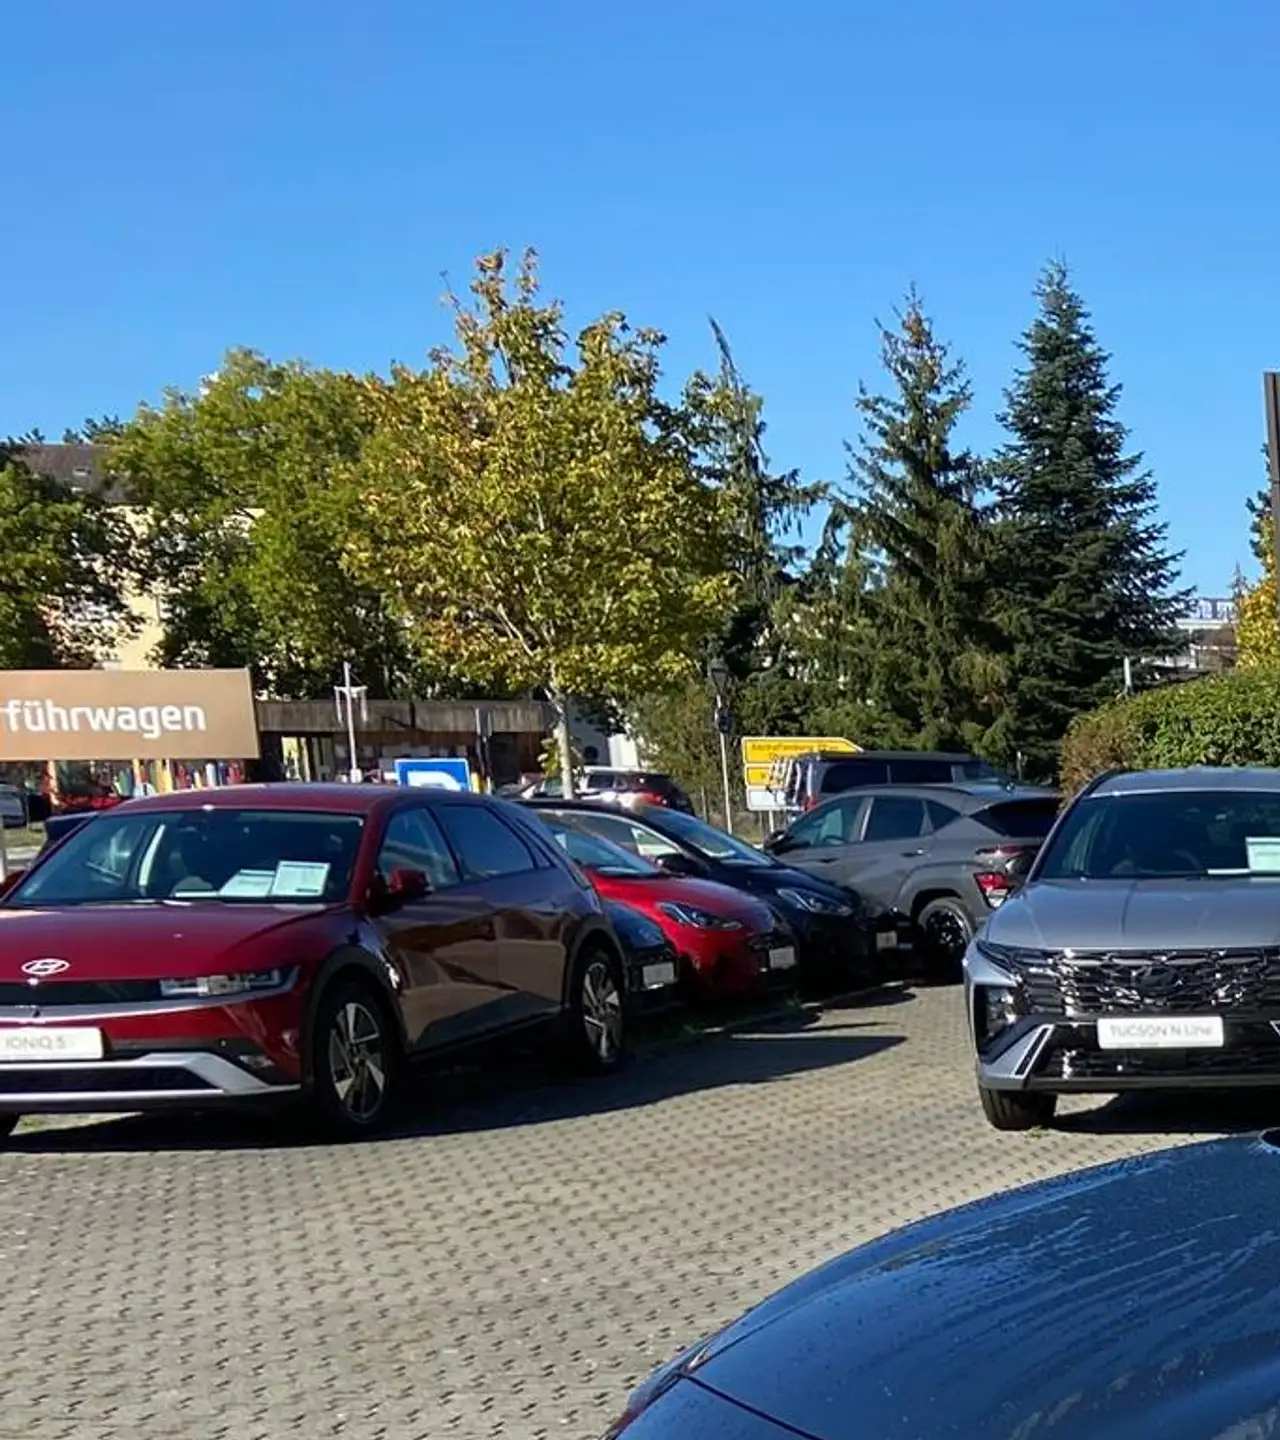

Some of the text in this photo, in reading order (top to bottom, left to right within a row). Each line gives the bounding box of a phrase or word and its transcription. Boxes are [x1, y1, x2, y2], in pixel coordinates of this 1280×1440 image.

[1110, 1023, 1167, 1037] TUCSON
[1170, 1024, 1181, 1036] N
[5, 1035, 53, 1051] IONIQ
